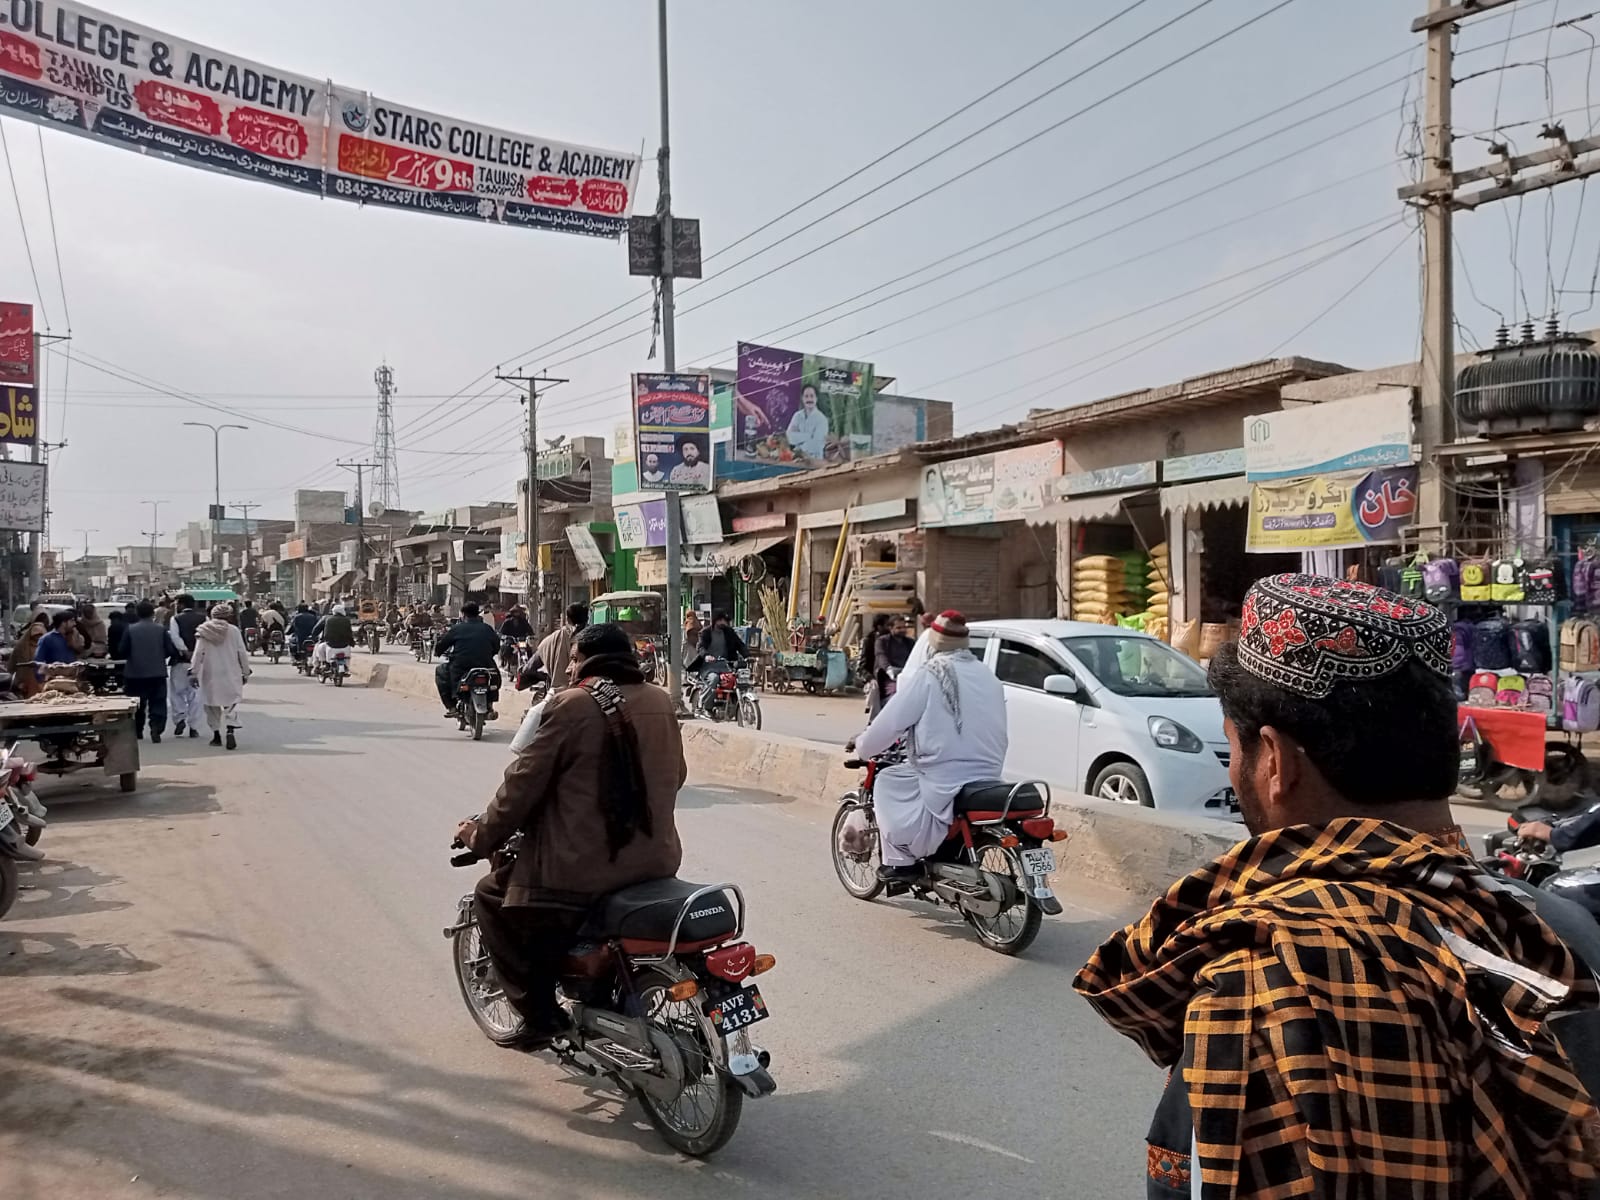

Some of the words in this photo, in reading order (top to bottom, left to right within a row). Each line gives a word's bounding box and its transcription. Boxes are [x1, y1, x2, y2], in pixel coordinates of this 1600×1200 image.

[0, 38, 40, 70] th
[0, 0, 140, 69] OLLEGE
[149, 41, 174, 79] &
[184, 52, 316, 117] ACADEMY
[45, 48, 129, 94] TAUNSA
[46, 66, 134, 110] CAMPUS
[270, 130, 300, 158] 40
[374, 106, 443, 157] STARS
[448, 126, 533, 170] COLLEGE
[538, 149, 553, 172] &
[557, 150, 636, 181] ACADEMY
[435, 159, 474, 191] 9th
[478, 166, 525, 189] TAUNSA
[606, 191, 624, 212] 40
[1359, 478, 1417, 529] خان
[689, 905, 726, 920] HONDA
[722, 993, 745, 1013] AVF
[722, 1006, 762, 1031] 4131
